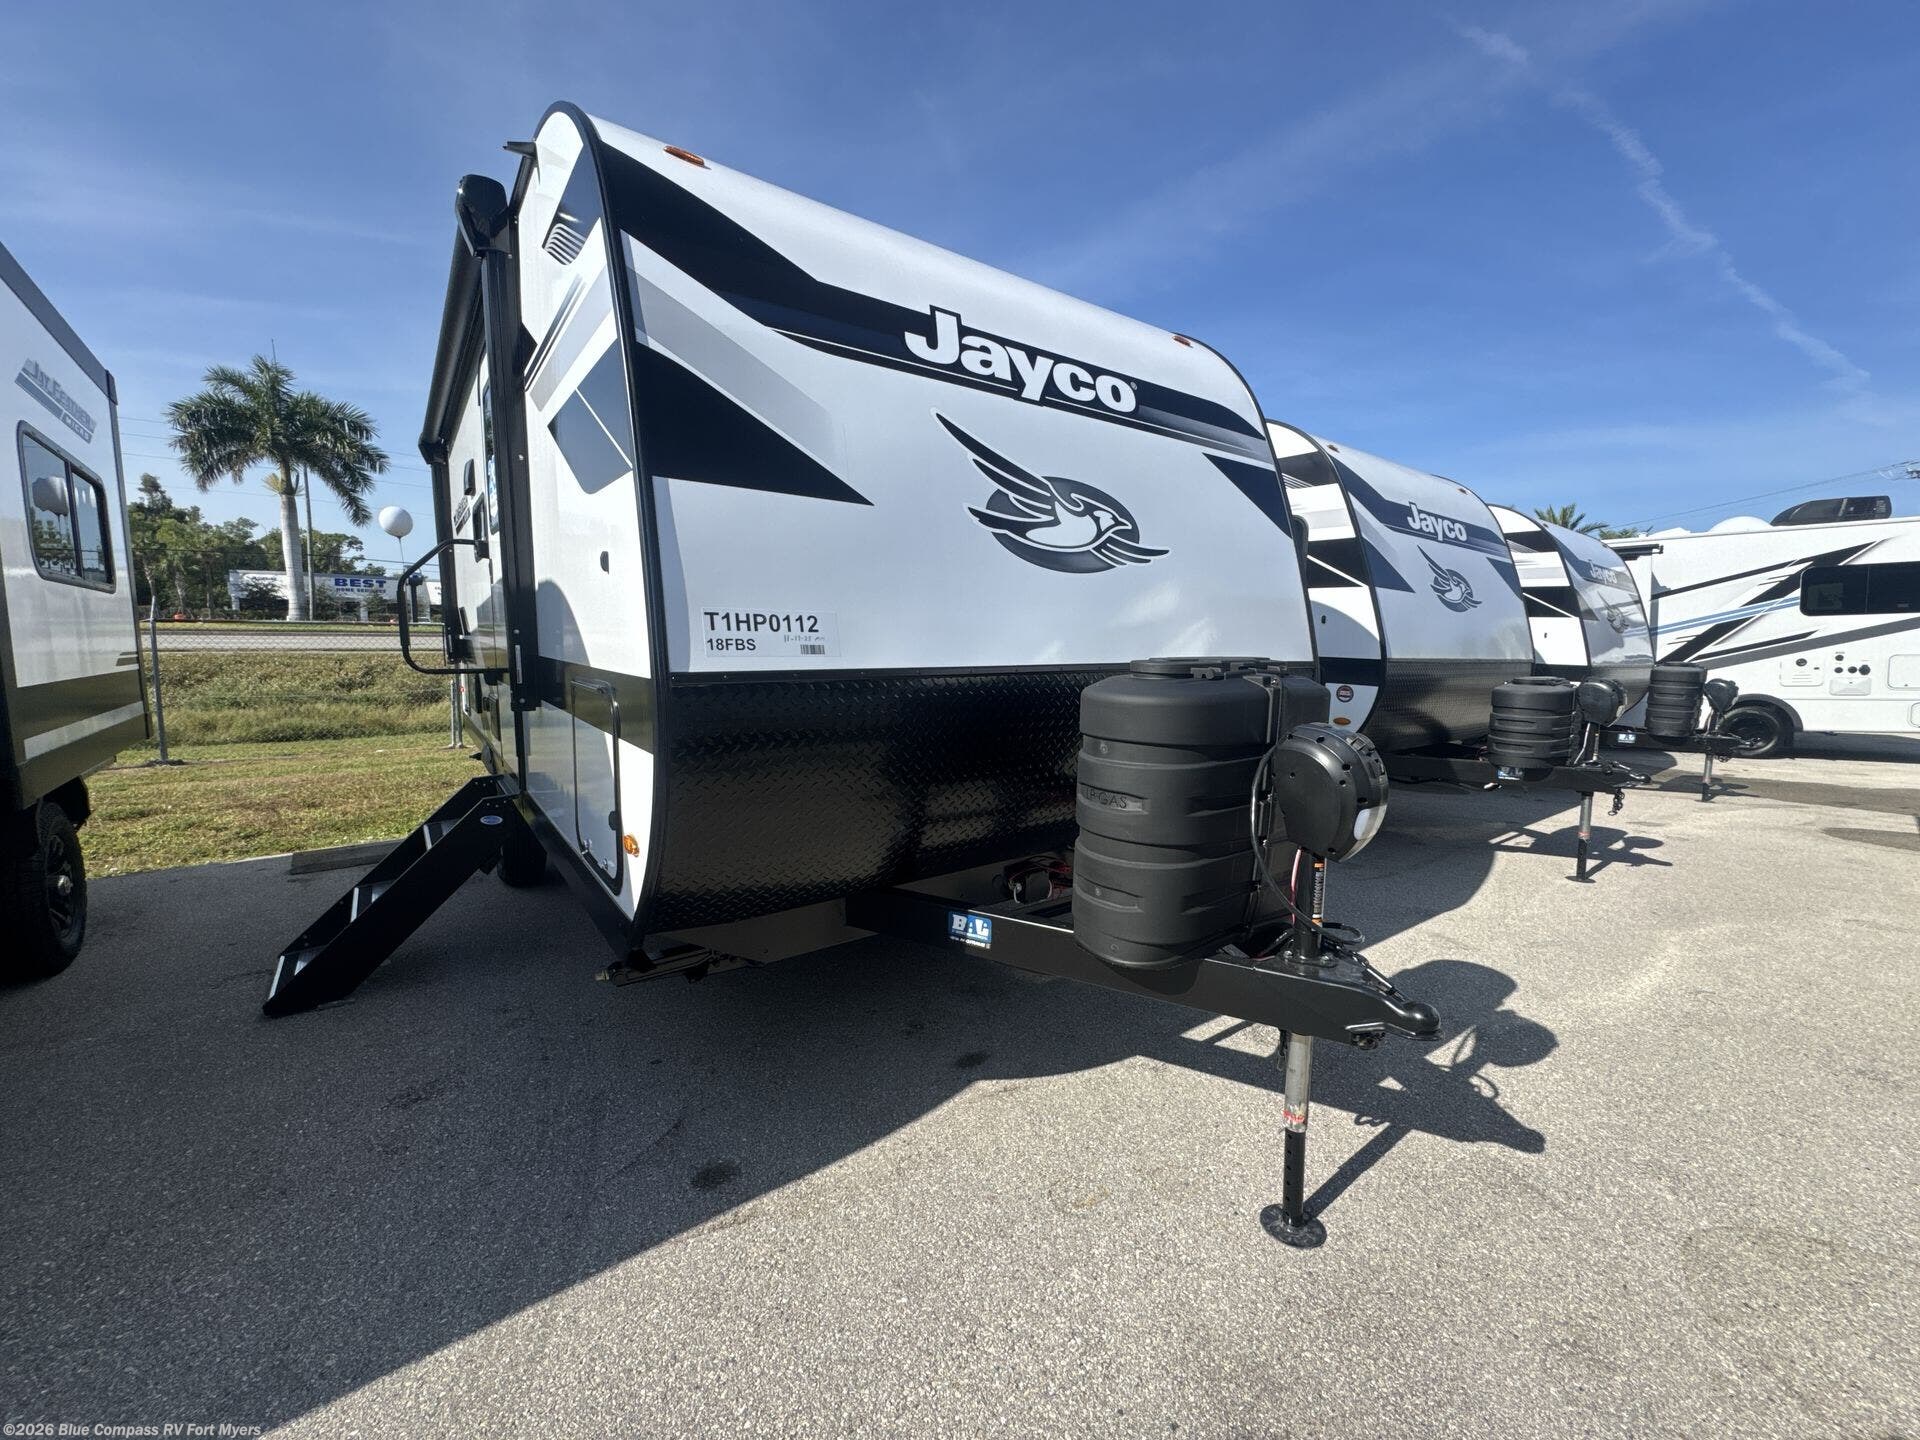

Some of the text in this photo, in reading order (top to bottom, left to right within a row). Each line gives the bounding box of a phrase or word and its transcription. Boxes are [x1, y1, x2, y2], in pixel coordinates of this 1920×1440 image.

[904, 310, 1136, 413] Jayco
[1407, 502, 1468, 542] Jayco
[334, 578, 387, 587] BEST
[1589, 560, 1618, 584] Jayco
[704, 612, 819, 633] T1HP0112
[707, 638, 756, 651] 18FBS
